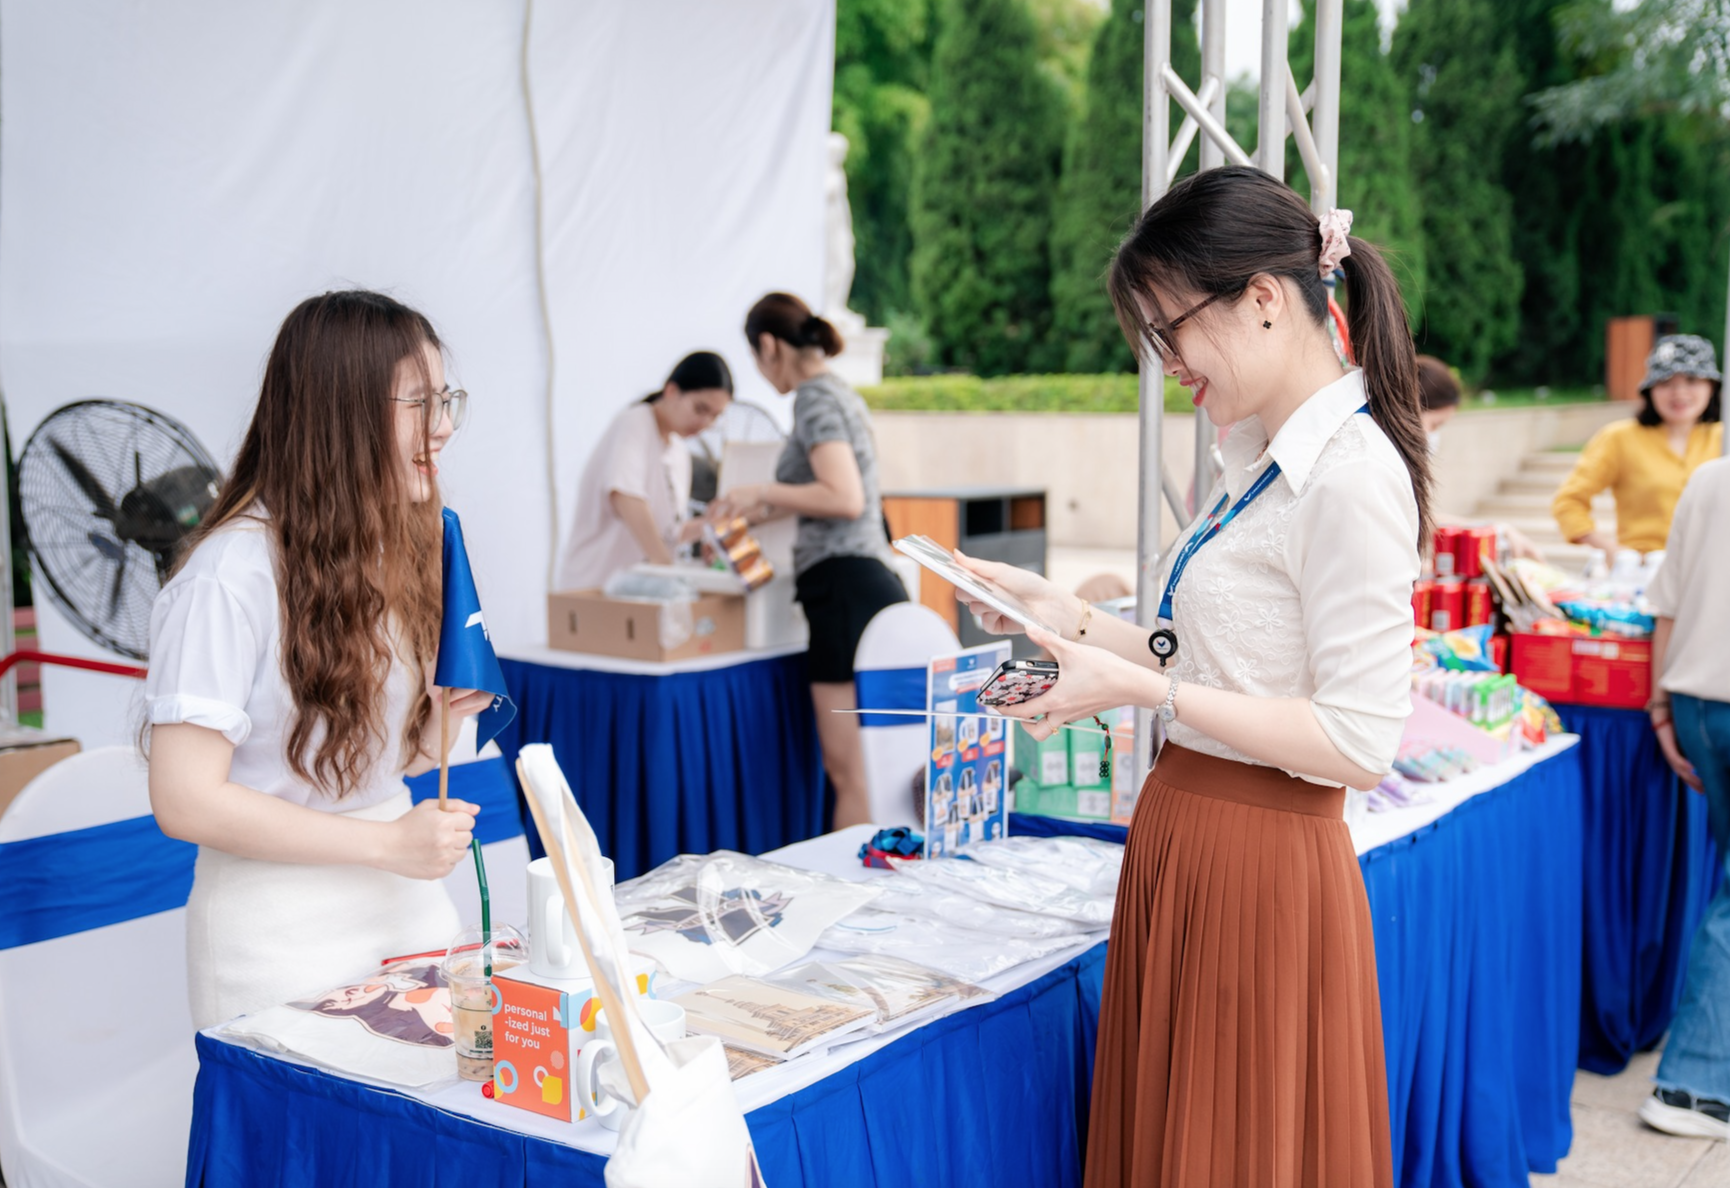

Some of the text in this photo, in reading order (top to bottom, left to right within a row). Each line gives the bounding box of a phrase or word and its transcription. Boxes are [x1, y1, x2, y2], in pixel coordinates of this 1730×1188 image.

[504, 1004, 547, 1021] personal
[505, 1016, 550, 1037] -ized just
[505, 1031, 540, 1049] for you
